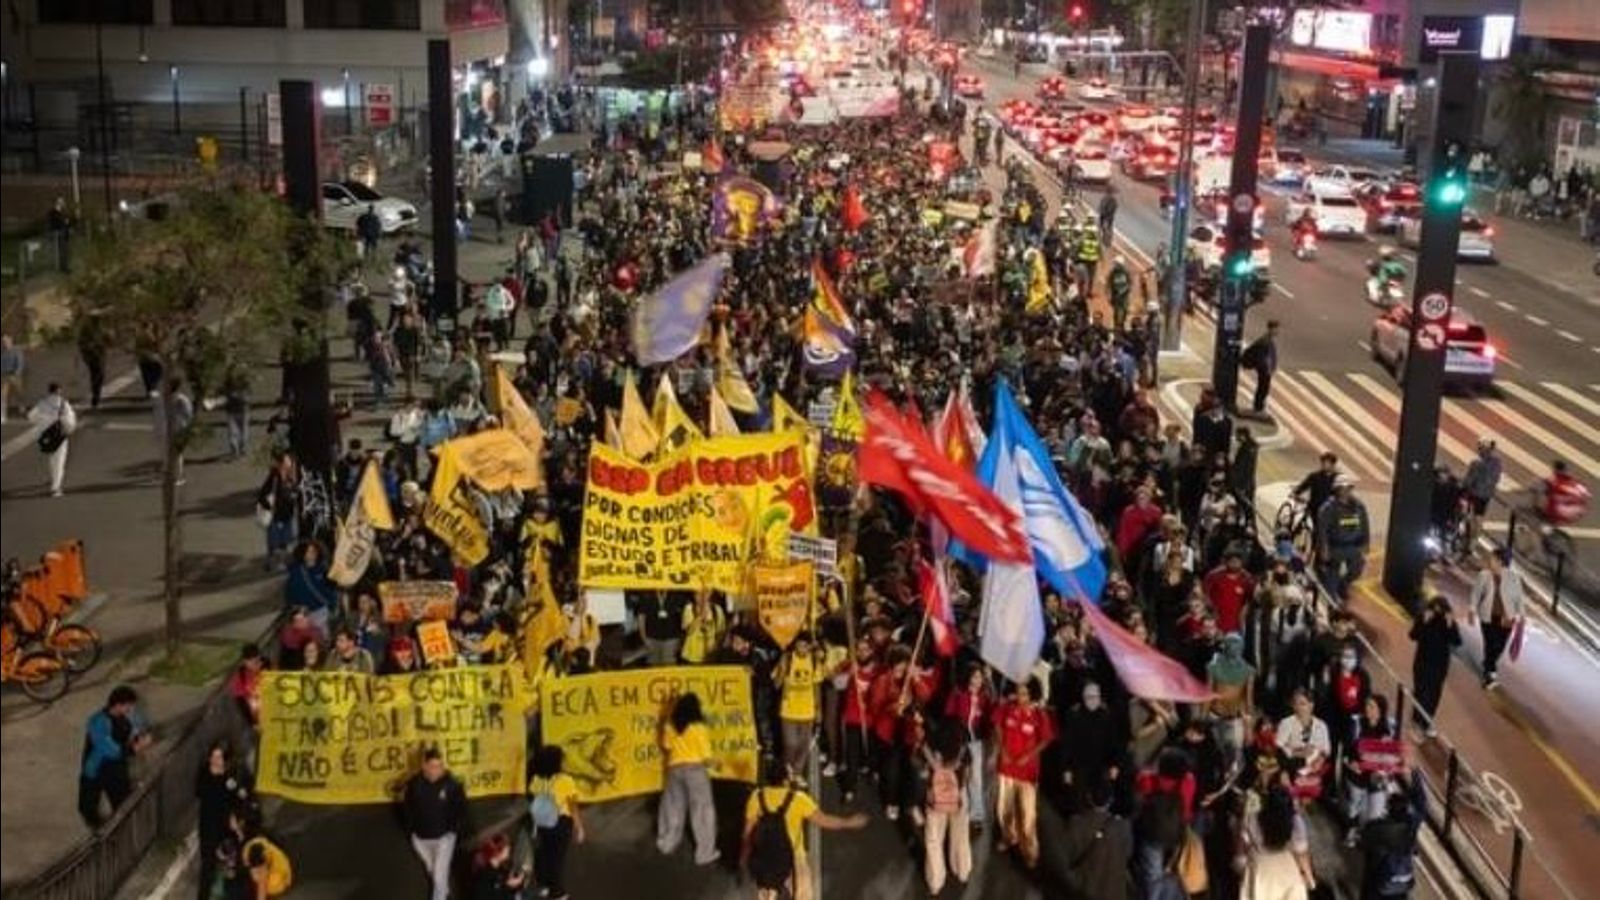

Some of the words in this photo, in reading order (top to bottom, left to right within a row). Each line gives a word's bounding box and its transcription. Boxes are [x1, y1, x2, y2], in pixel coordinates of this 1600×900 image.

[587, 491, 623, 519] POR
[586, 518, 655, 547] DIGNAS
[664, 515, 690, 545] DE
[586, 540, 656, 564] ESTUDO
[409, 670, 514, 703] CONTRA
[551, 686, 599, 717] ECA
[608, 685, 639, 707] EM
[414, 702, 504, 733] LUTAR
[278, 750, 332, 780] NÃO
[341, 745, 358, 775] É
